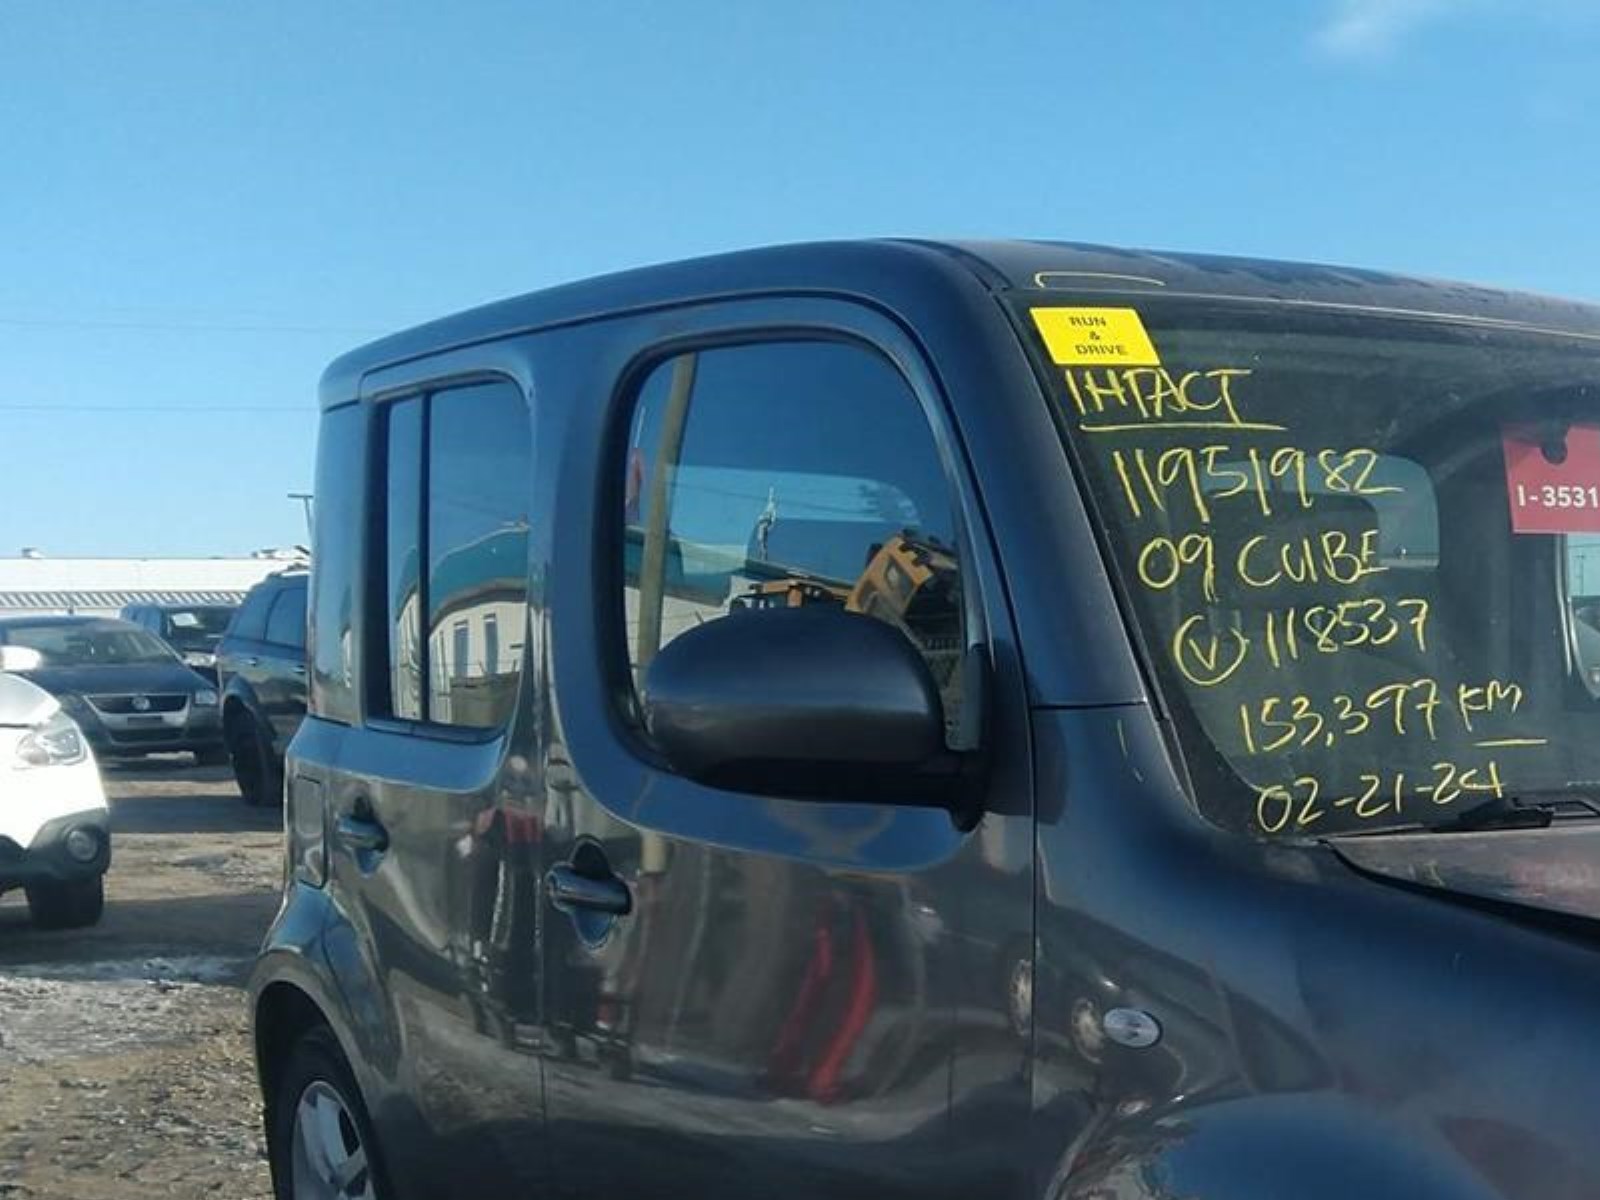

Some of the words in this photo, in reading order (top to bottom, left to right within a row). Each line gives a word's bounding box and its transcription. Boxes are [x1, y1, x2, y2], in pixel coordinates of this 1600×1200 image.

[1068, 316, 1107, 326] RUN
[1075, 345, 1128, 355] DRIVE
[1112, 445, 1404, 523] 11951982
[1138, 534, 1219, 602] 09
[1237, 530, 1390, 586] CUBE
[1266, 599, 1429, 667] 118537
